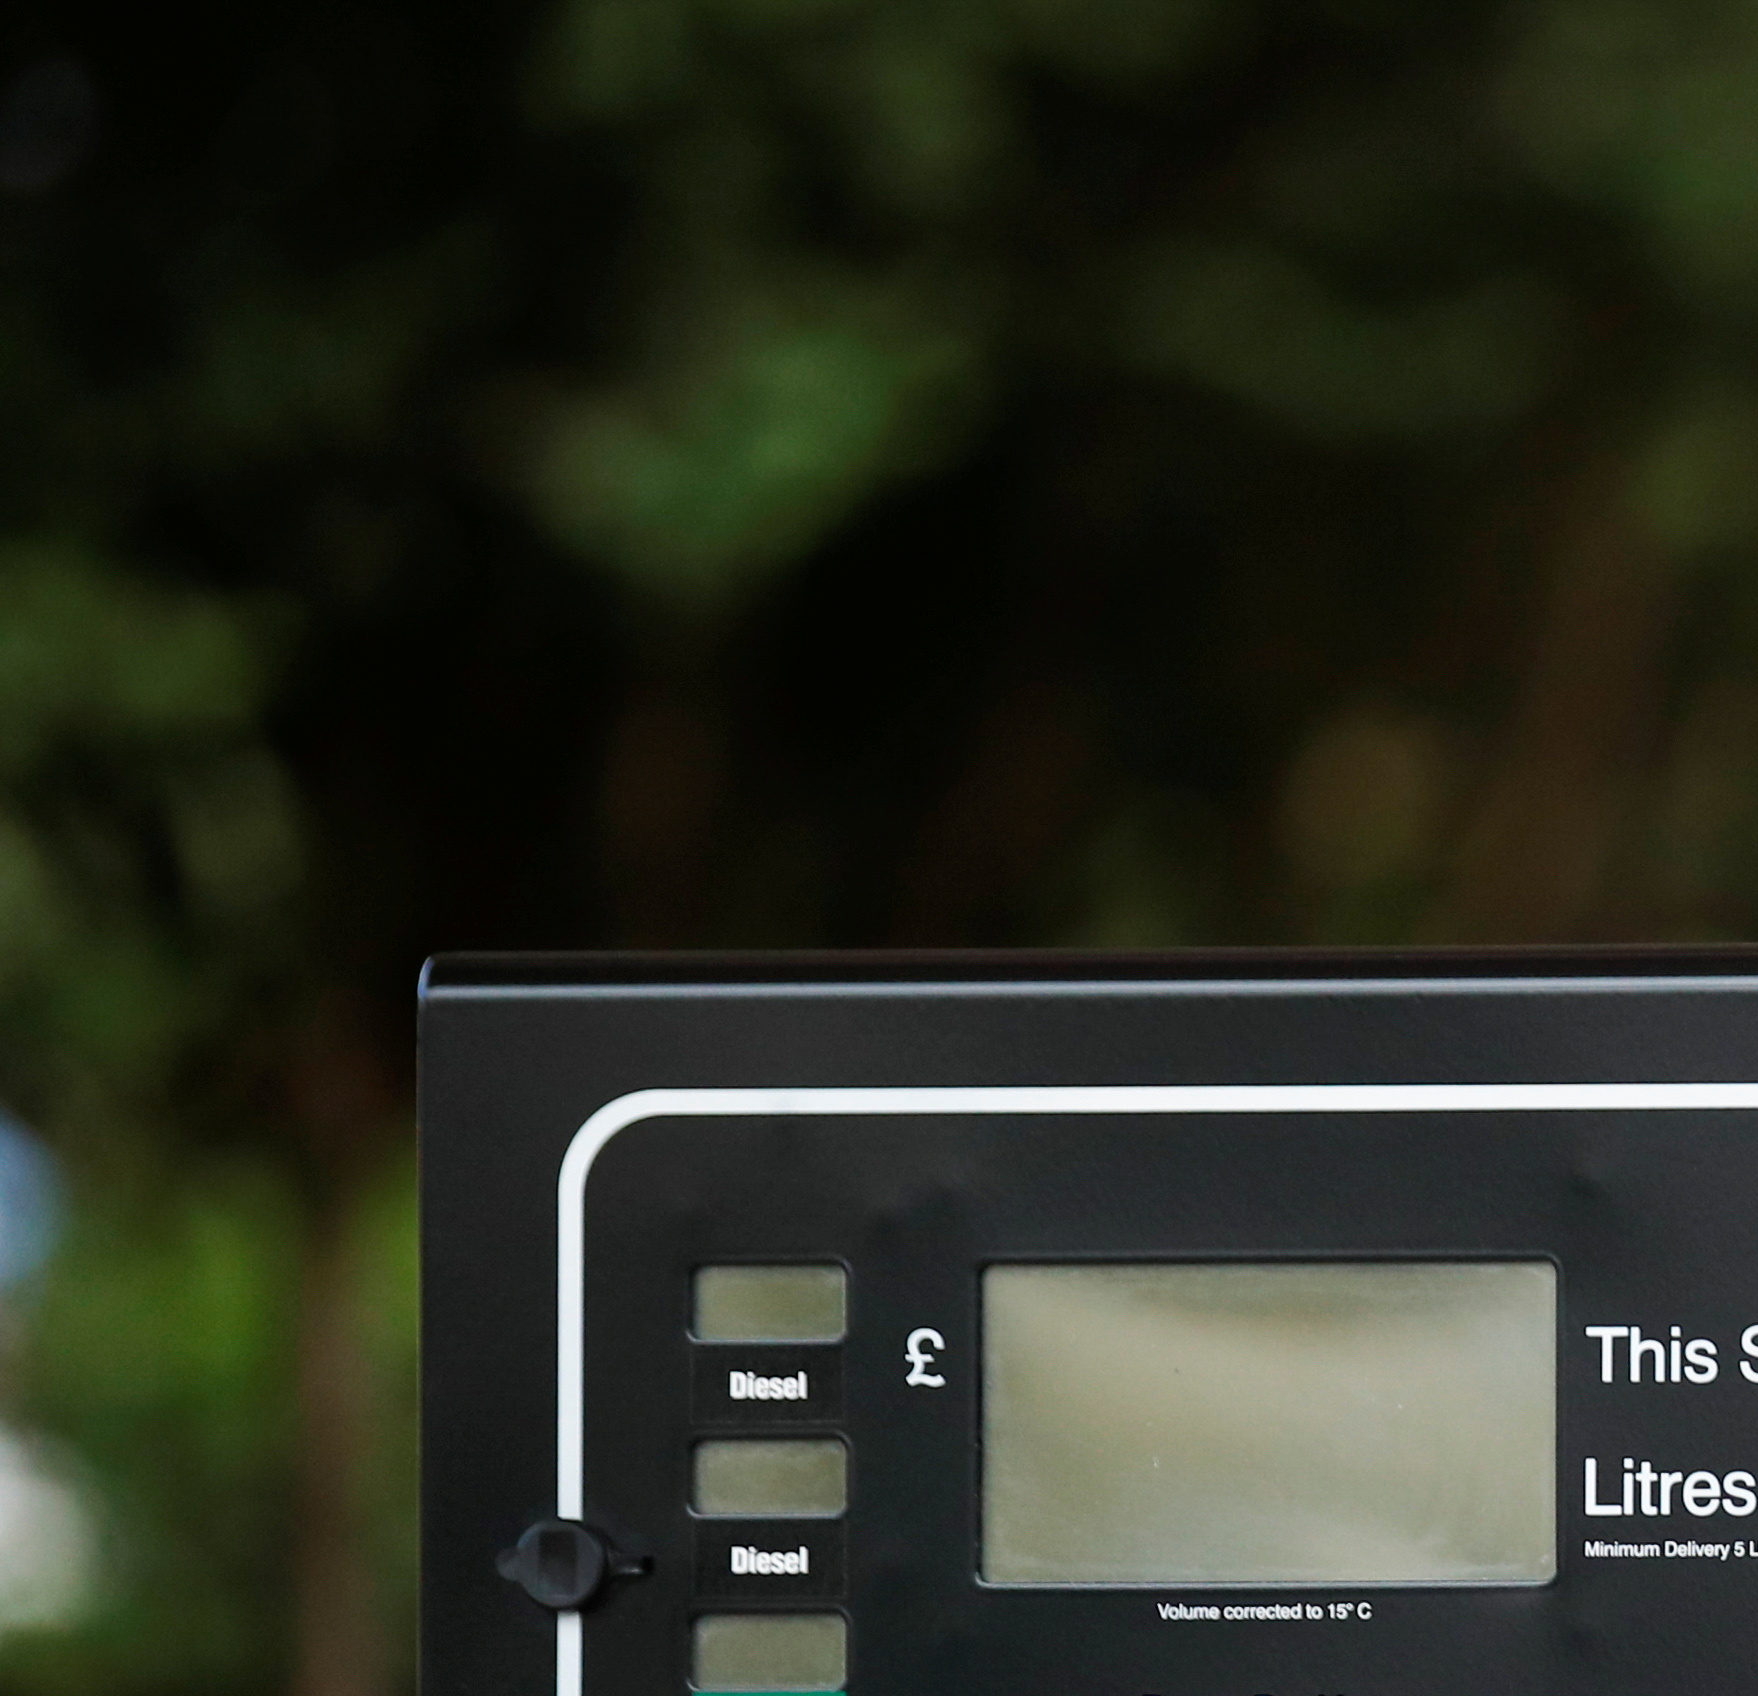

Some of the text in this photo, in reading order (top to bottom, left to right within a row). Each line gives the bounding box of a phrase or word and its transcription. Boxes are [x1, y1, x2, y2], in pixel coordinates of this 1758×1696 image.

[905, 1328, 945, 1387] £
[1586, 1327, 1718, 1383] This
[730, 1371, 807, 1399] Diesel
[1585, 1458, 1756, 1516] Litres
[731, 1547, 808, 1574] Diesel
[1585, 1541, 1660, 1557] Minimum
[1665, 1541, 1730, 1560] Delivery
[1734, 1541, 1745, 1557] 5
[1157, 1603, 1220, 1620] Volume
[1224, 1603, 1302, 1619] corrected
[1306, 1604, 1323, 1619] to
[1357, 1602, 1371, 1619] C
